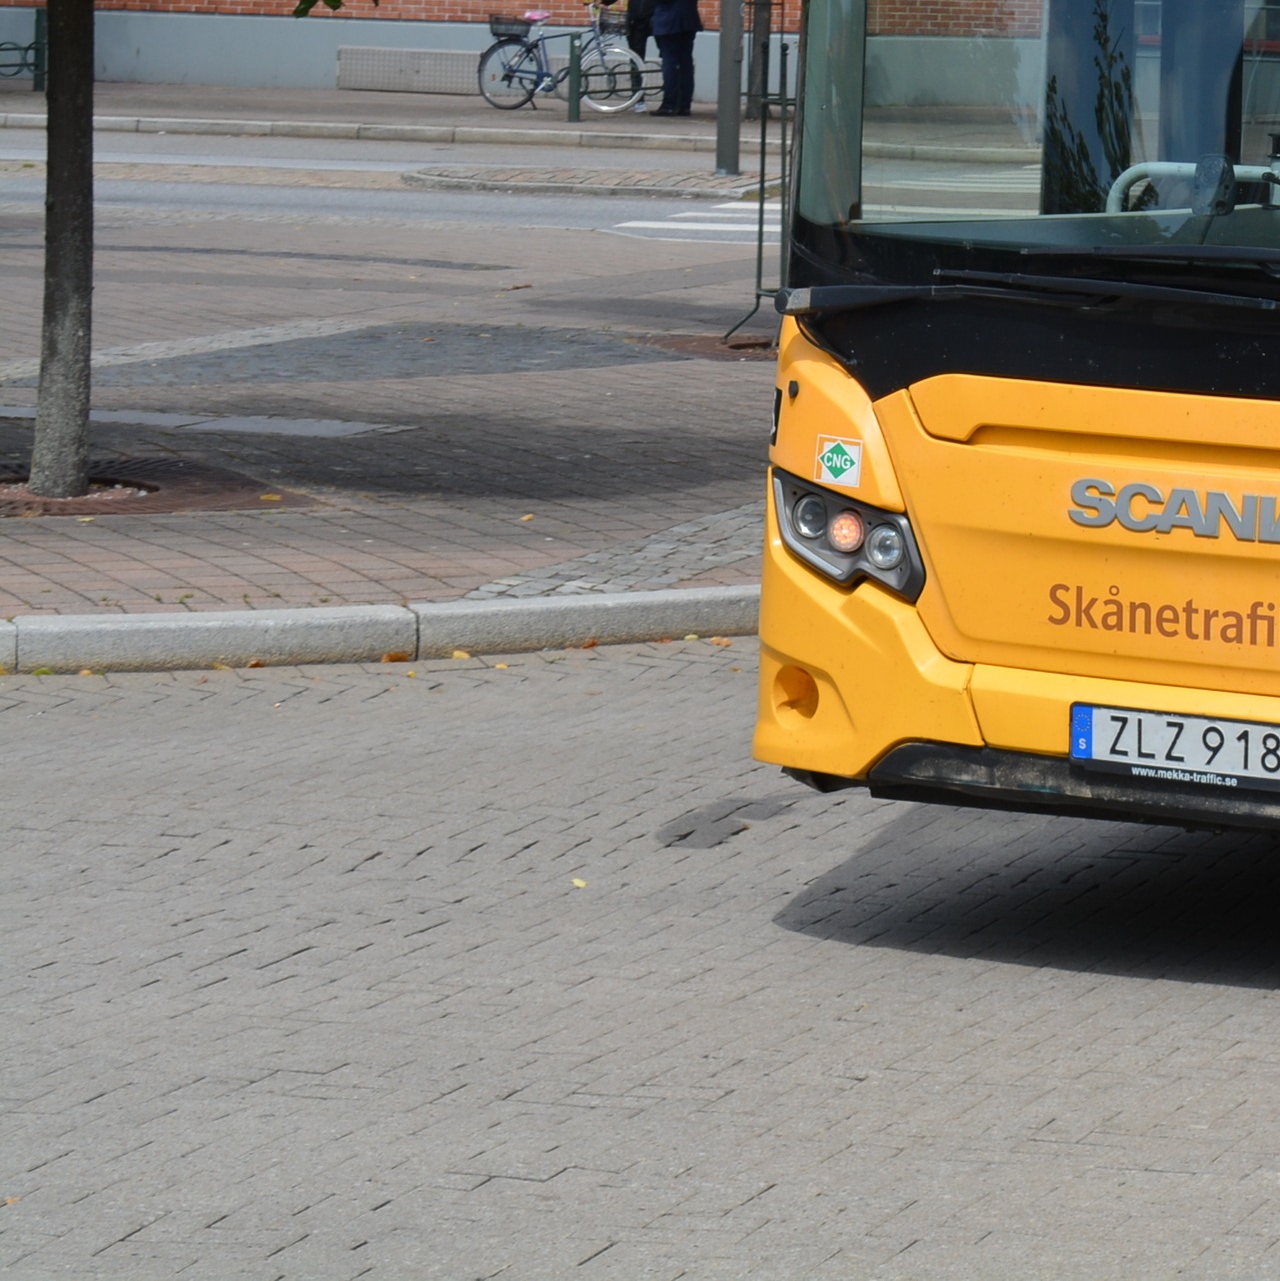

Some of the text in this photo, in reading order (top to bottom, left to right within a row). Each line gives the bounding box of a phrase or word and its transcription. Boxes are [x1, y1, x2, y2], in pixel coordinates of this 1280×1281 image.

[823, 452, 851, 470] CNG
[1078, 738, 1087, 749] S
[1109, 715, 1186, 763] ZLZ
[1131, 766, 1238, 787] www.mekka-traffic.se
